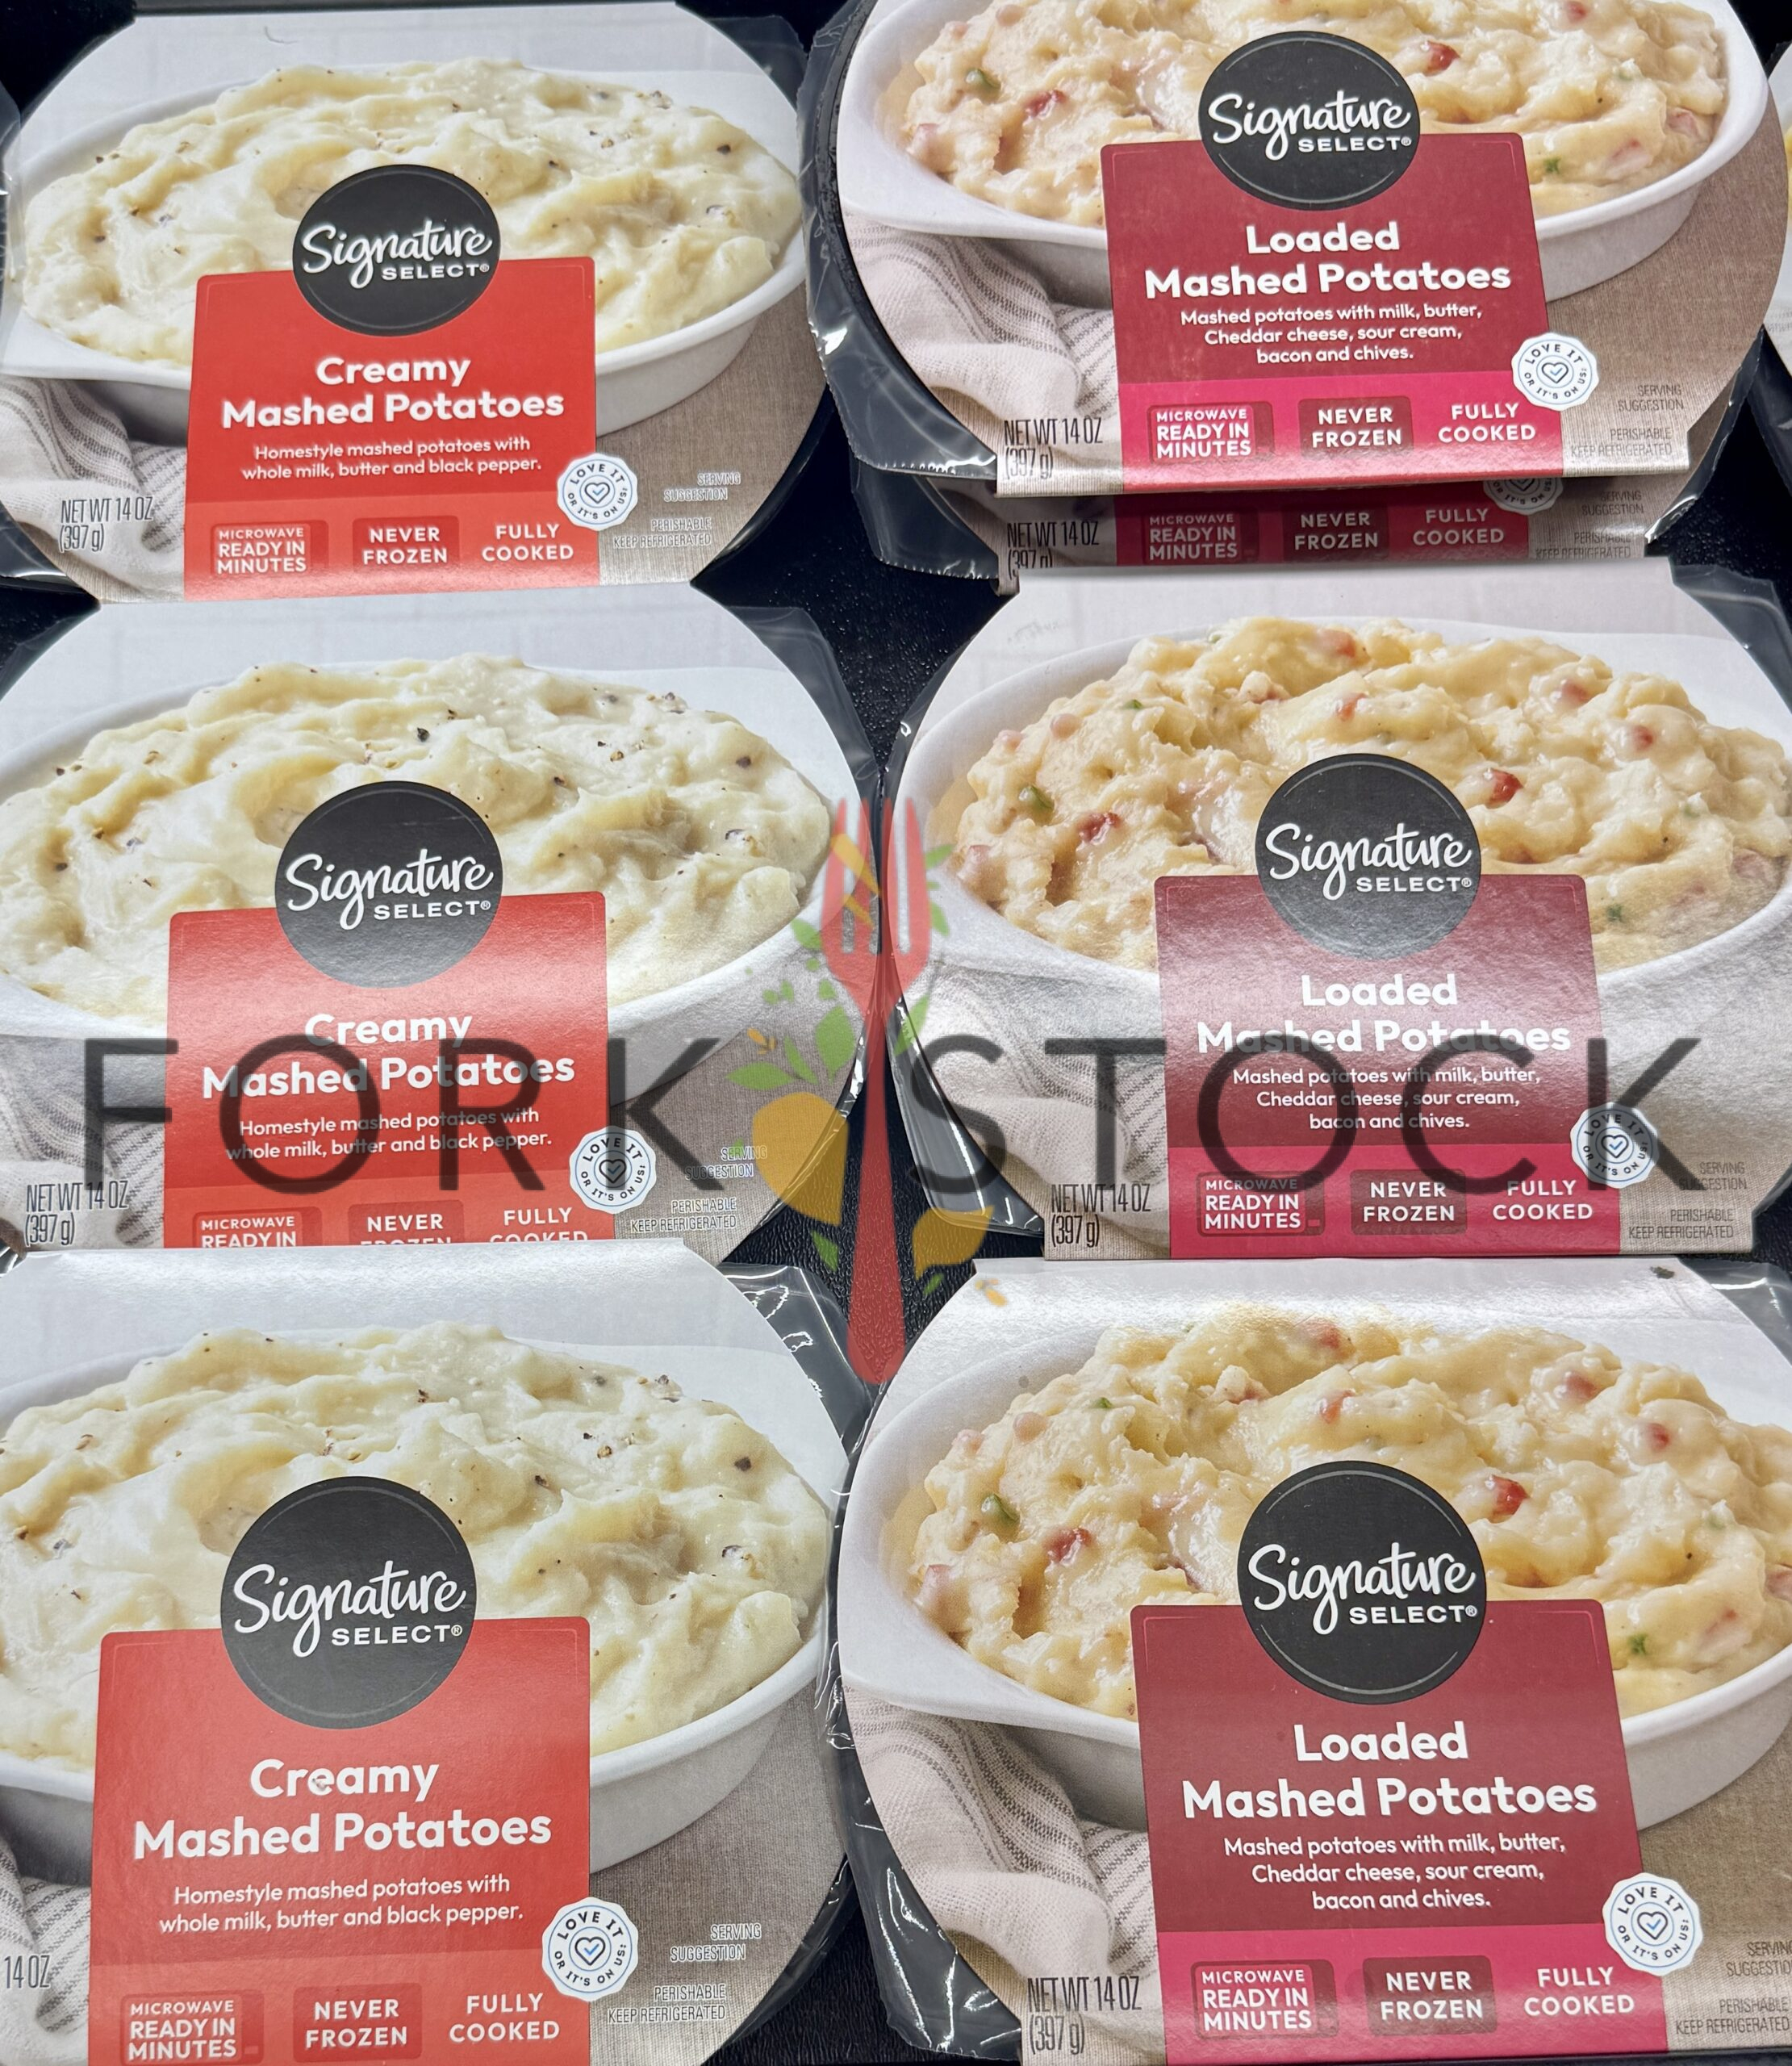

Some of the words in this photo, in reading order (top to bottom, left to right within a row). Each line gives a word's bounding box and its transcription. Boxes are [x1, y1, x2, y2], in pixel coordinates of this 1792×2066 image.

[1209, 90, 1411, 160] Signature
[1247, 221, 1399, 253] Loaded
[303, 220, 492, 288] Signature
[1146, 263, 1307, 299] Mashed
[1318, 262, 1510, 292] Potatoes
[1181, 308, 1250, 325] Mashed
[1255, 307, 1333, 326] potatoes
[1337, 305, 1375, 320] with
[1379, 304, 1420, 320] milk,
[1424, 303, 1481, 318] butter,
[1205, 328, 1283, 345] Cheddar
[1287, 327, 1353, 342] cheese,
[1358, 328, 1395, 339] sour
[1400, 326, 1461, 339] cream,
[1257, 349, 1312, 363] bacon
[1316, 346, 1349, 362] and
[1354, 345, 1413, 360] chives.
[316, 357, 470, 387] Creamy
[223, 394, 374, 428] Mashed
[386, 391, 563, 421] Potatoes
[1157, 409, 1247, 422] MICROWAVE
[1318, 407, 1393, 424] NEVER
[1452, 403, 1518, 420] FULLY
[1004, 419, 1031, 445] NET
[1034, 418, 1058, 445] WT
[1062, 418, 1080, 444] 14
[1083, 416, 1103, 444] OZ
[1157, 423, 1225, 441] READY
[1313, 429, 1401, 447] FROZEN
[1439, 424, 1535, 442] COOKED
[255, 444, 343, 460] Homestyle
[348, 440, 412, 456] mashed
[417, 439, 491, 457] potatoes
[495, 436, 530, 450] with
[1157, 440, 1251, 458] MINUTES
[242, 465, 291, 479] whole
[296, 463, 334, 479] milk,
[339, 462, 389, 475] butter
[429, 458, 474, 472] black
[478, 459, 541, 475] pepper.
[61, 500, 87, 523] NET
[90, 498, 112, 522] WT
[116, 496, 131, 521] 14
[135, 496, 153, 521] OZ
[1150, 514, 1233, 525] MICROWAVE
[1426, 508, 1488, 523] FULLY
[1301, 512, 1370, 528] NEVER
[219, 528, 303, 539] MICROWAVE
[370, 527, 440, 542] NEVER
[496, 524, 559, 539] FULLY
[1151, 527, 1213, 542] READY
[1295, 533, 1377, 550] FROZEN
[1414, 529, 1504, 545] COOKED
[219, 542, 282, 557] READY
[363, 548, 446, 564] FROZEN
[482, 545, 573, 561] COOKED
[1150, 542, 1237, 560] MINUTES
[217, 557, 306, 574] MINUTES
[1266, 823, 1472, 900] Signature
[286, 849, 493, 930] Signature
[1301, 971, 1459, 1006] Loaded
[304, 1013, 473, 1048] Creamy
[1197, 1021, 1363, 1059] Mashed
[1374, 1020, 1570, 1056] Potatoes
[203, 1058, 367, 1098] Mashed
[382, 1054, 574, 1089] Potatoes
[1206, 1179, 1299, 1192] MICROWAVE
[1371, 1182, 1446, 1198] NEVER
[1508, 1180, 1576, 1195] FULLY
[27, 1184, 55, 1212] NET
[58, 1182, 83, 1211] WT
[86, 1181, 104, 1210] 14
[108, 1180, 128, 1209] OZ
[1206, 1194, 1274, 1211] READY
[1280, 1194, 1298, 1209] IN
[504, 1207, 571, 1225] FULLY
[1205, 1213, 1301, 1229] MINUTES
[1364, 1206, 1454, 1222] FROZEN
[1493, 1204, 1593, 1219] COOKED
[25, 1214, 58, 1246] (397
[202, 1216, 294, 1230] MICROWAVE
[368, 1214, 443, 1232] NEVER
[1249, 1542, 1477, 1634] Signature
[234, 1561, 466, 1657] Signature
[1294, 1721, 1468, 1761] Loaded
[251, 1759, 439, 1802] Creamy
[1183, 1778, 1365, 1818] Mashed
[1377, 1777, 1597, 1815] Potatoes
[134, 1813, 320, 1859] Mashed
[335, 1809, 551, 1851] Potatoes
[1225, 1837, 1302, 1855] Mashed
[1308, 1837, 1397, 1859] potatoes
[1400, 1834, 1443, 1852] with
[1448, 1833, 1495, 1854] milk,
[1499, 1833, 1565, 1852] butter,
[1252, 1863, 1340, 1883] Cheddar
[1346, 1863, 1421, 1883] cheese,
[1426, 1866, 1468, 1880] sour
[1473, 1864, 1543, 1880] cream,
[174, 1883, 282, 1906] Homestyle
[287, 1879, 367, 1902] mashed
[373, 1878, 462, 1901] potatoes
[467, 1874, 509, 1894] with
[1313, 1891, 1375, 1909] bacon
[1380, 1889, 1418, 1908] and
[1422, 1888, 1490, 1907] chives.
[160, 1913, 219, 1934] whole
[224, 1911, 272, 1934] milk,
[277, 1909, 339, 1928] butter
[344, 1906, 382, 1926] and
[387, 1904, 441, 1924] black
[447, 1906, 523, 1926] pepper.
[557, 1911, 601, 1941] LOVE
[605, 1918, 624, 1938] IT
[711, 1923, 762, 1941] SERVING
[670, 1944, 746, 1962] SUGGESTION
[4, 1955, 25, 1989] 14
[28, 1955, 50, 1988] OZ
[1202, 1970, 1304, 1984] MICROWAVE
[1386, 1971, 1472, 1991] NEVER
[1538, 1967, 1613, 1987] FULLY
[654, 1984, 726, 2001] PERISHABLE
[1027, 1977, 1059, 2012] NET
[1061, 1976, 1089, 2011] WT
[1094, 1976, 1115, 2011] 14
[1118, 1975, 1142, 2010] OZ
[1203, 1989, 1280, 2008] READY
[1285, 1988, 1308, 2006] IN
[131, 2001, 233, 2015] MICROWAVE
[315, 1999, 399, 2020] NEVER
[467, 1993, 543, 2014] FULLY
[1381, 1999, 1482, 2020] FROZEN
[1524, 1995, 1634, 2016] COOKED
[608, 2008, 637, 2023] KEEP
[641, 2005, 726, 2022] REFRIGERATED
[1204, 2010, 1311, 2030] MINUTES
[131, 2018, 207, 2040] READY
[212, 2017, 235, 2037] IN
[307, 2026, 407, 2048] FROZEN
[449, 2021, 559, 2043] COOKED
[129, 2039, 236, 2060] MINUTES
